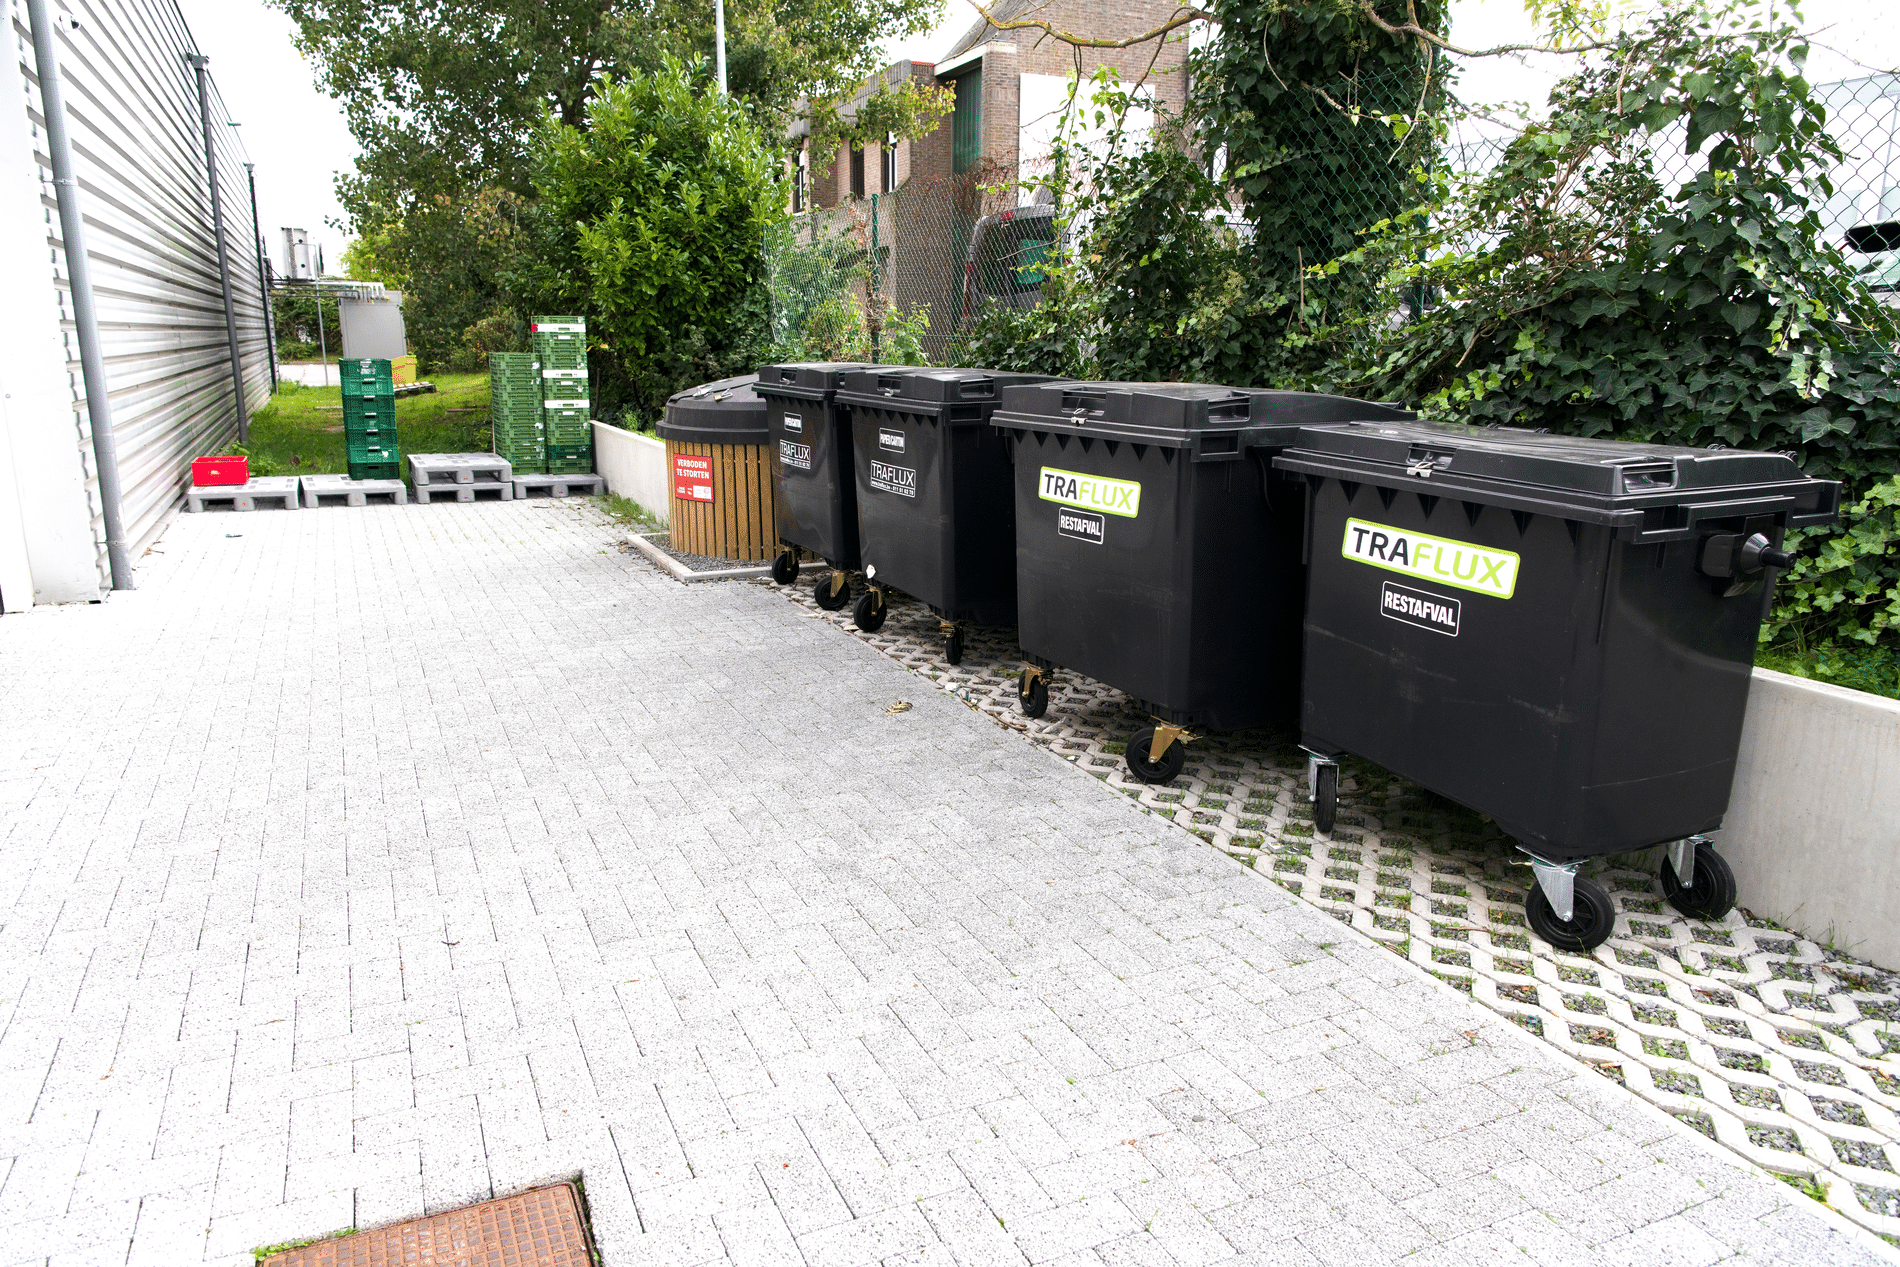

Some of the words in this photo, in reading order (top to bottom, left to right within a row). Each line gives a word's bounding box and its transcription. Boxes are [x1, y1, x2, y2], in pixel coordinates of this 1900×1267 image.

[780, 442, 810, 460] TRAFLUX
[676, 468, 683, 477] TE
[683, 469, 710, 479] STORTEN
[677, 459, 708, 469] VERBODEN
[872, 463, 914, 487] TRAFLUX
[1044, 473, 1134, 510] TRAFLUX
[1060, 515, 1101, 536] RESTAFVAL
[1353, 527, 1507, 588] TRAFLUX
[1384, 590, 1456, 627] RESTAFVAL
